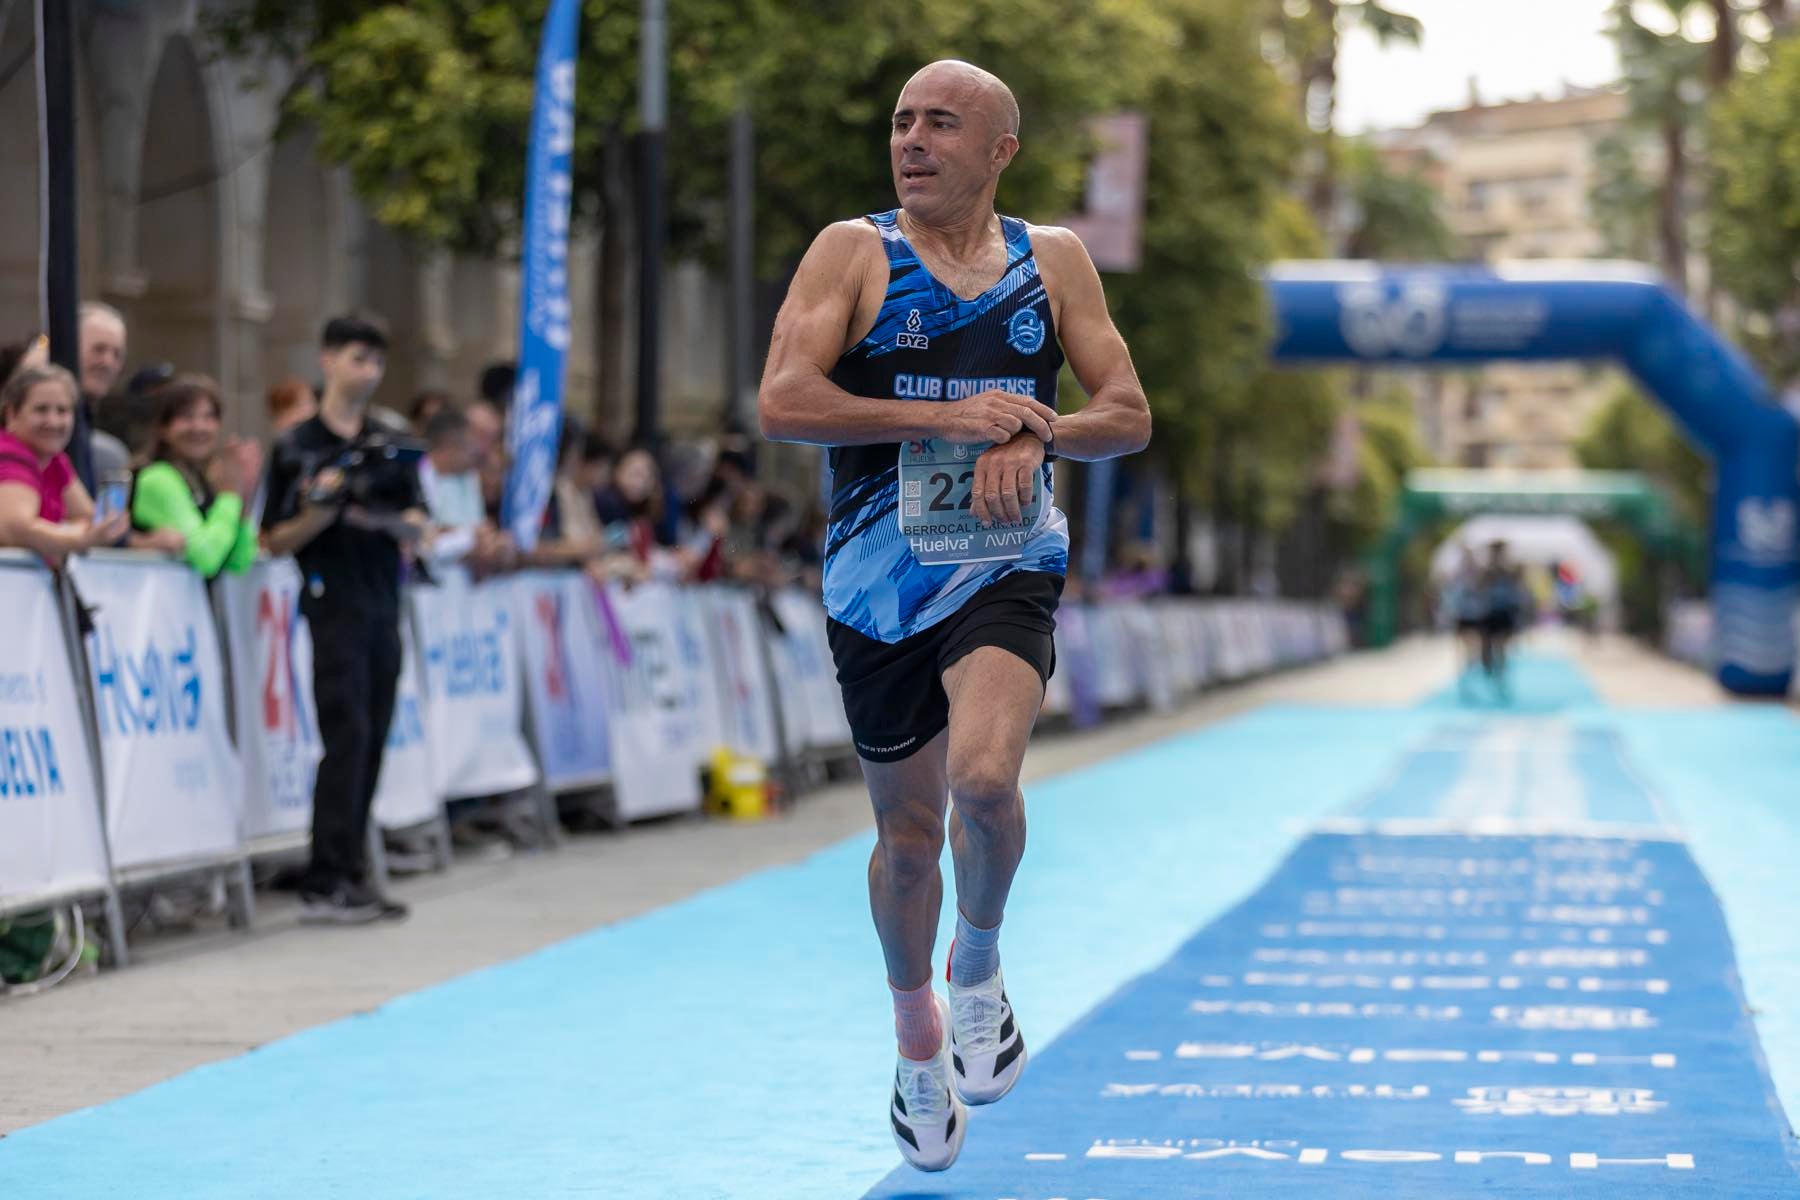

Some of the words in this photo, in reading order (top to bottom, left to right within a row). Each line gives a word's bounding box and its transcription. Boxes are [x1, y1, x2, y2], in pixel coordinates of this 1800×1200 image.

[896, 333, 928, 349] BY2
[894, 374, 942, 399] CLUB
[904, 522, 972, 537] BERROCAL
[910, 535, 969, 552] Huelva
[1086, 1145, 1696, 1169] Huelva
